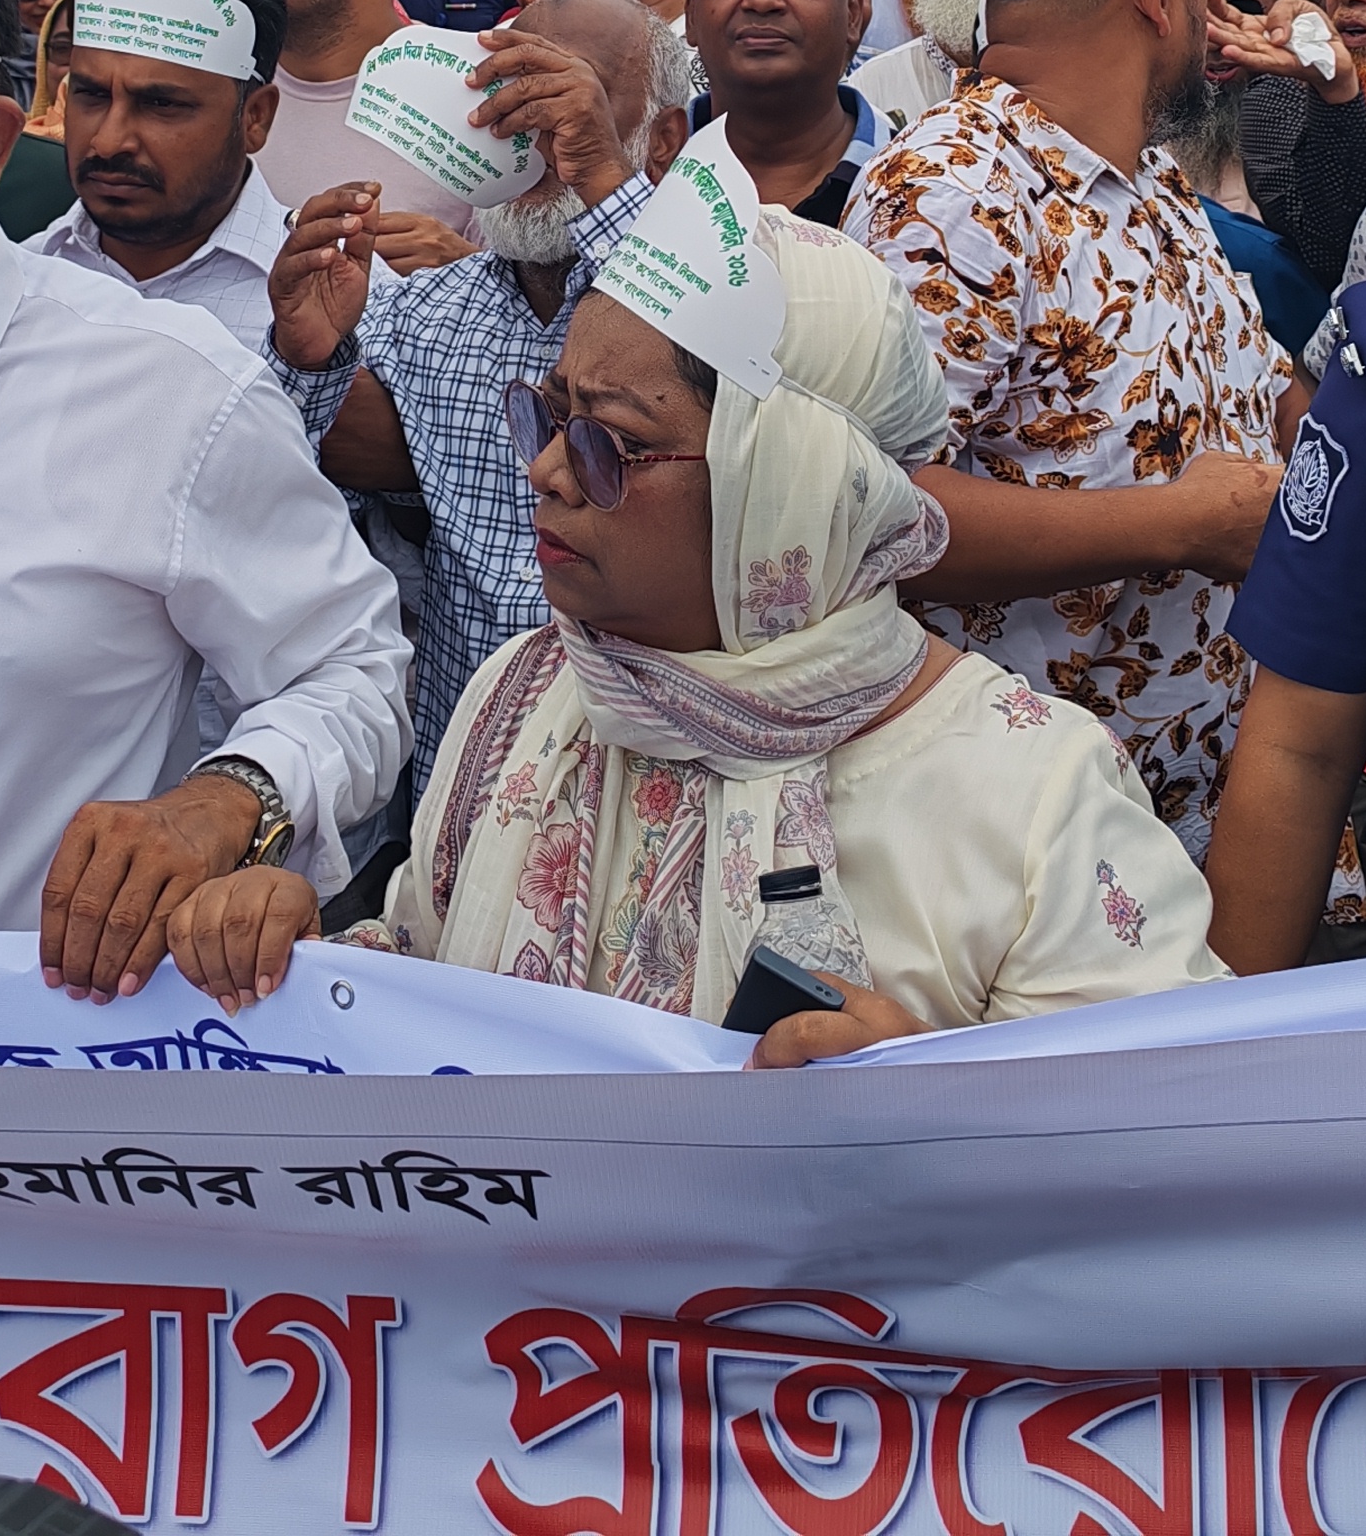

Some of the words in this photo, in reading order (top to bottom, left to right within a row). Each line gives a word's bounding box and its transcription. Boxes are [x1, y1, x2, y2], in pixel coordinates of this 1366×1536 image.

[438, 165, 475, 196] বাংলাদেশ
[445, 151, 485, 186] কর্পোরেশন
[624, 279, 674, 321] বাংলাদেশ
[282, 1148, 550, 1223] রাহিম
